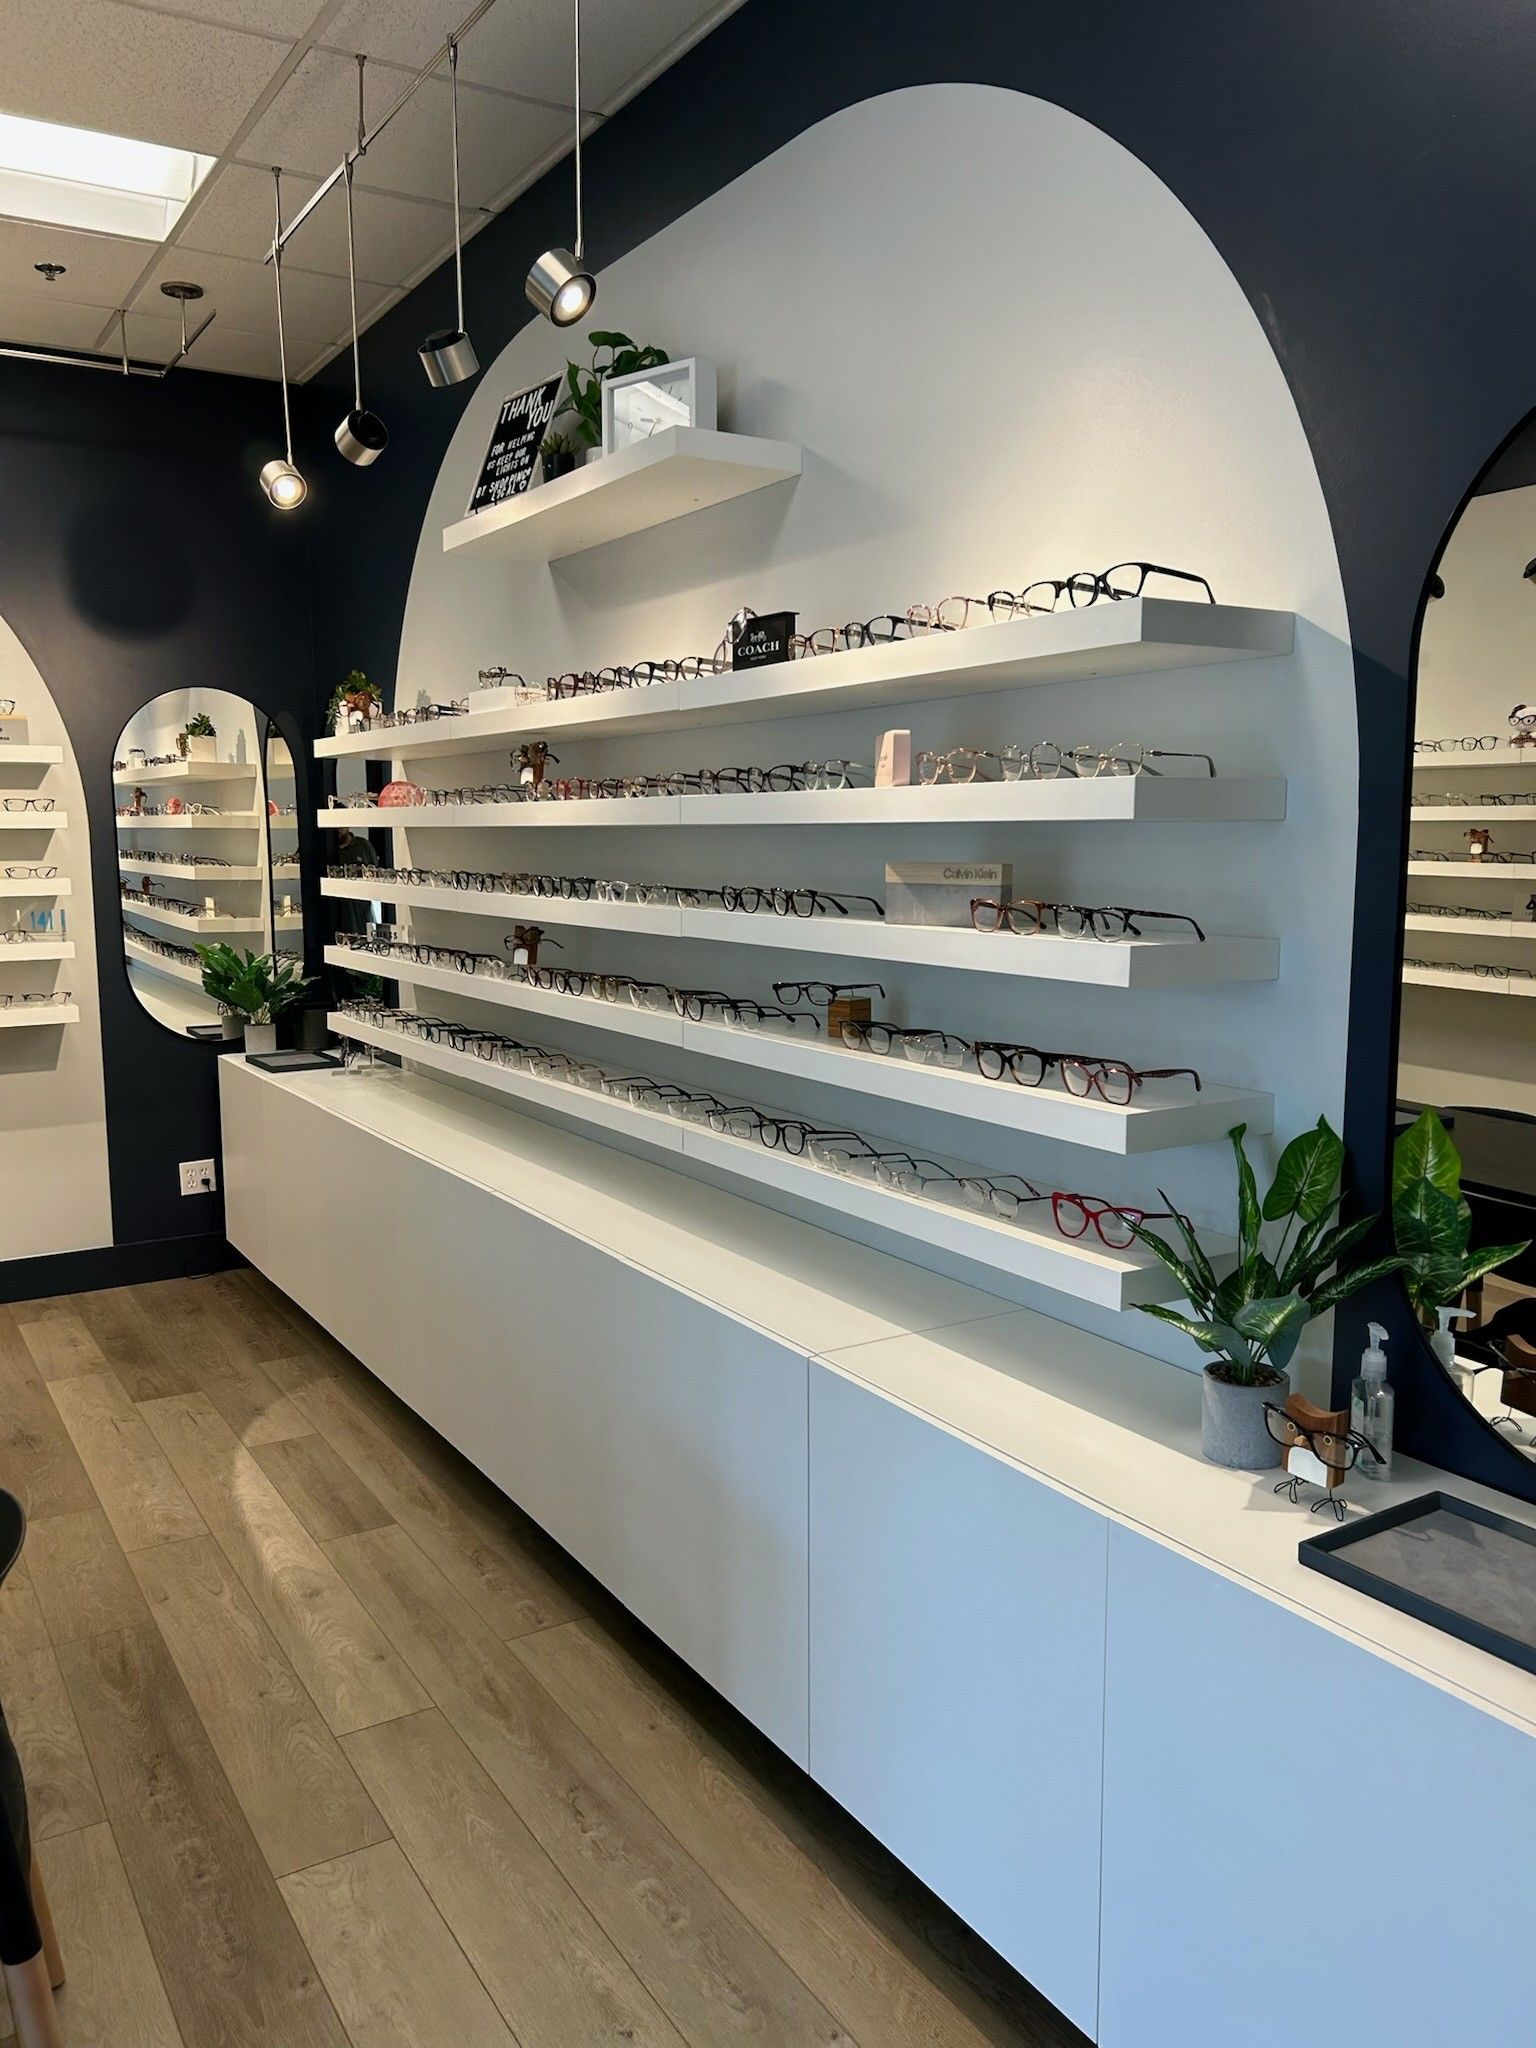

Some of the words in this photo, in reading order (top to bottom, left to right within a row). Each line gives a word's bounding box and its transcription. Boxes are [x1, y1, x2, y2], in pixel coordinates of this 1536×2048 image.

[501, 386, 546, 424] THANK
[527, 400, 554, 430] YOU
[491, 441, 505, 457] FOR
[496, 459, 519, 476] LIGHTS
[520, 454, 531, 466] ON
[476, 485, 487, 499] BY
[737, 640, 780, 657] COACH
[943, 867, 973, 879] Calvin
[974, 867, 998, 879] Klein
